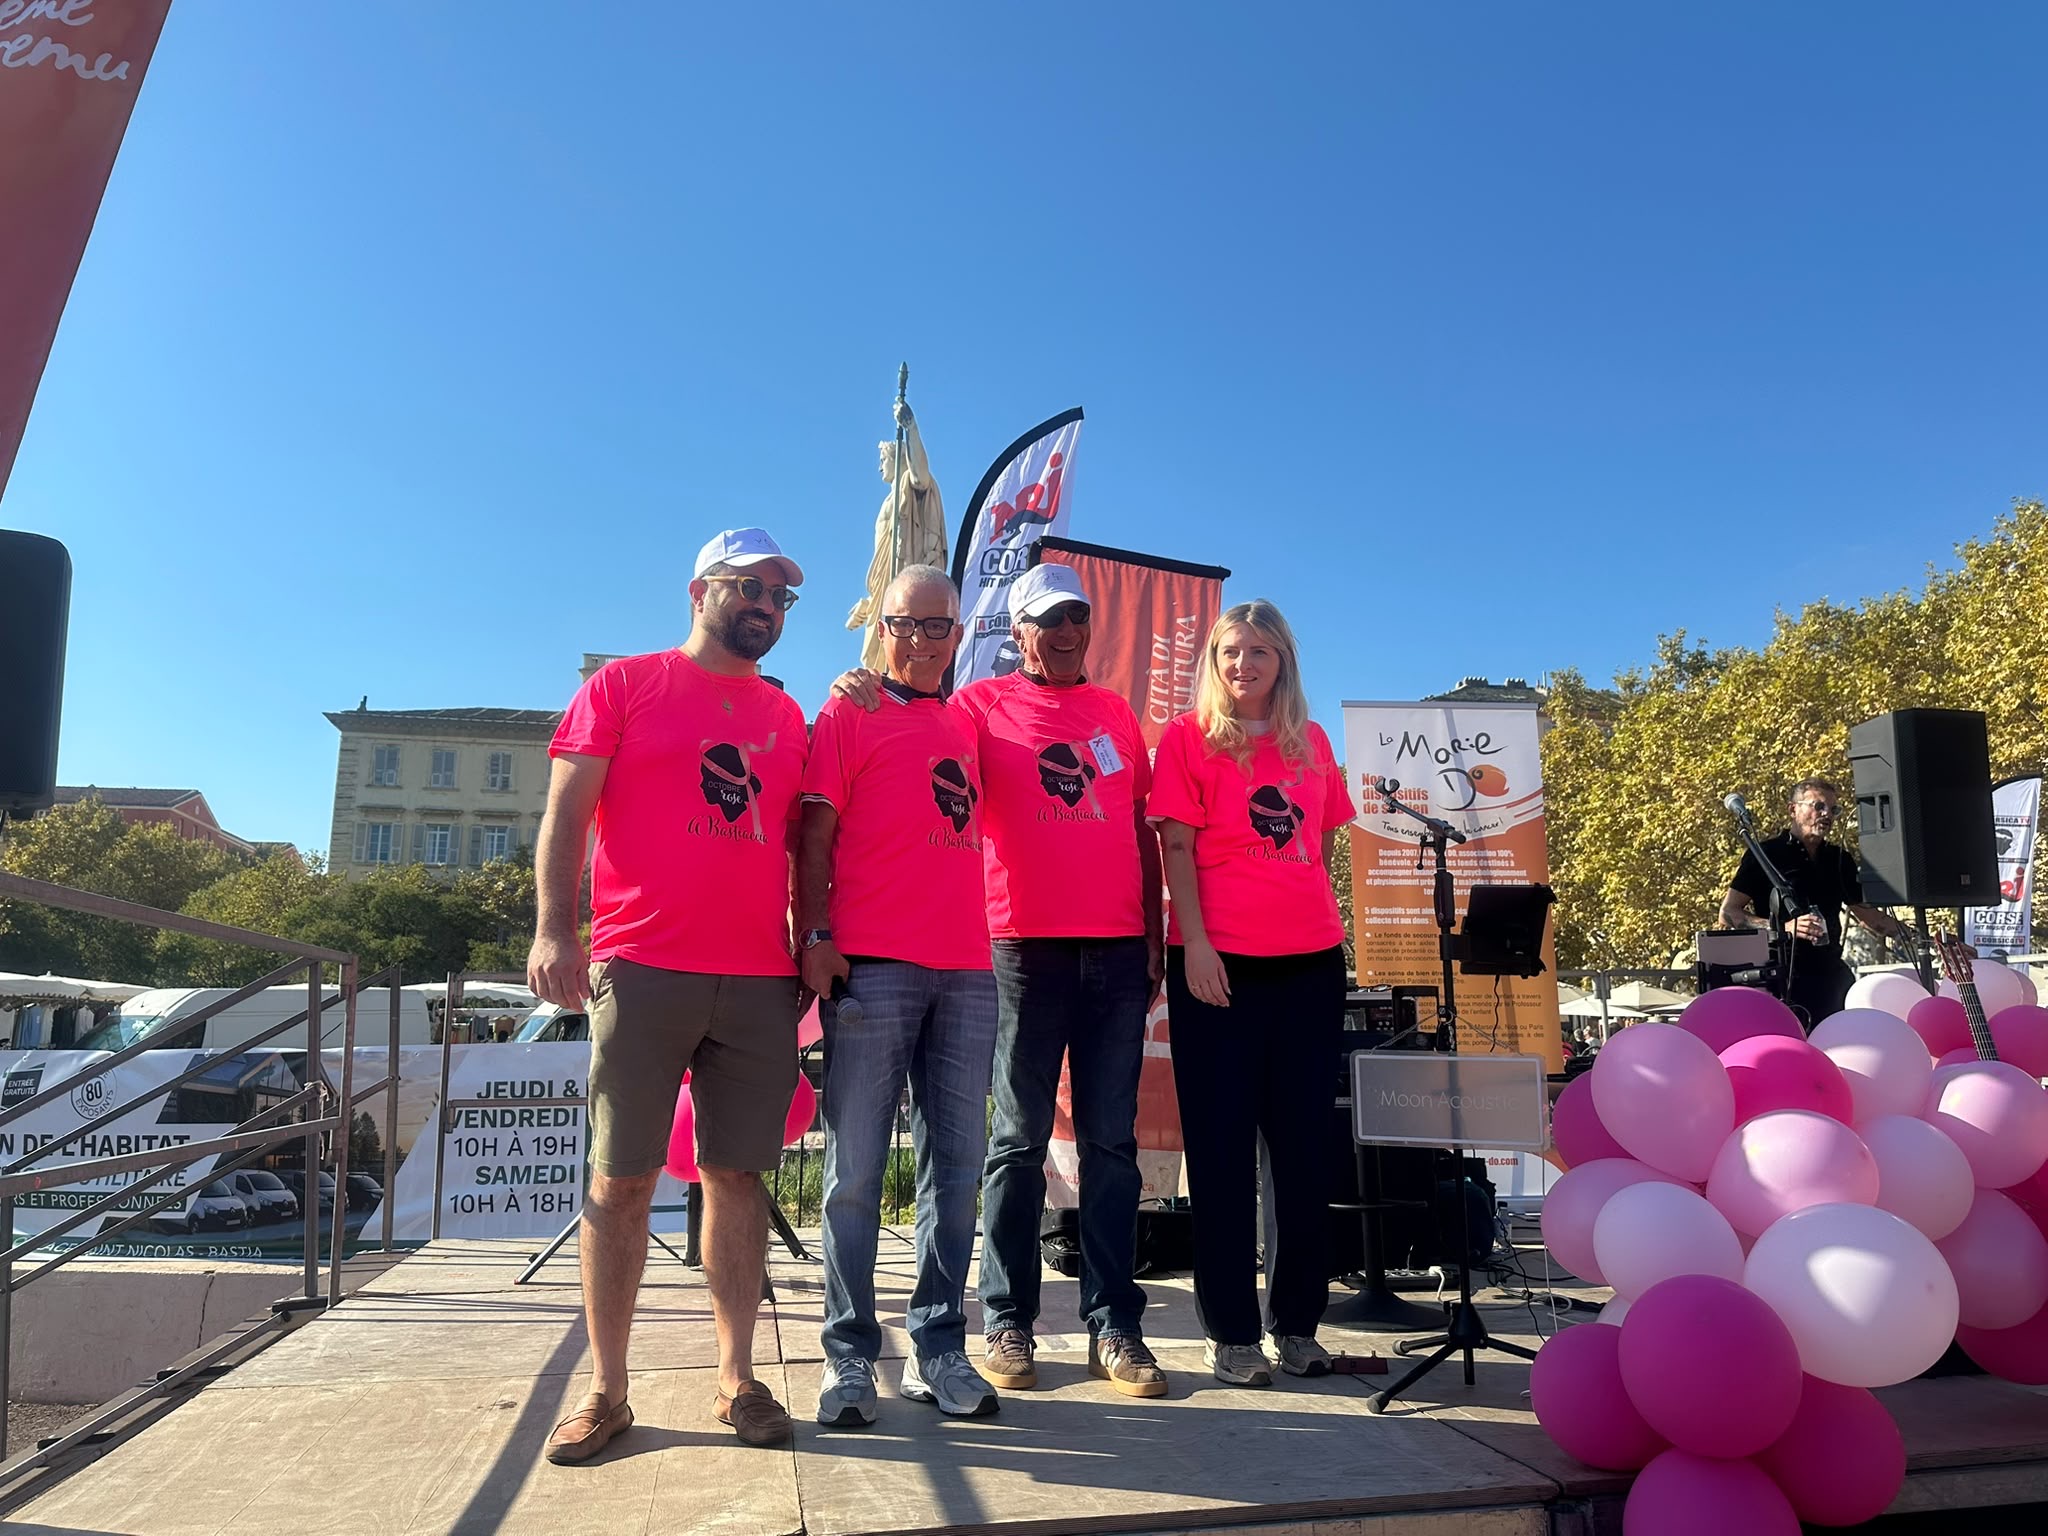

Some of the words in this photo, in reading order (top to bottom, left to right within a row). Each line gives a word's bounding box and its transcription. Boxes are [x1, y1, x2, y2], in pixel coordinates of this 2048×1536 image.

[981, 547, 1028, 575] COR
[979, 576, 996, 588] HIT
[1152, 632, 1171, 665] DI
[1145, 667, 1170, 725] CITÀ
[708, 780, 742, 793] OCTOBRE
[1363, 787, 1429, 800] disositifs
[720, 789, 743, 805] rose
[1363, 802, 1379, 814] de
[1975, 911, 2023, 925] CORSE
[3, 1087, 36, 1097] GRATUITE
[86, 1080, 103, 1102] 80
[476, 1080, 553, 1099] JEUDI
[562, 1079, 580, 1098] &
[75, 1089, 114, 1118] EXPOSANTS
[1380, 1090, 1433, 1108] Moon
[1438, 1091, 1521, 1110] Acoustic
[454, 1137, 498, 1157] 10H
[507, 1130, 524, 1156] À
[532, 1135, 577, 1156] 19H
[475, 1164, 575, 1185] SAMEDI
[30, 1194, 45, 1206] ET
[450, 1194, 494, 1213] 10H
[504, 1188, 520, 1213] À
[529, 1193, 574, 1213] 18H
